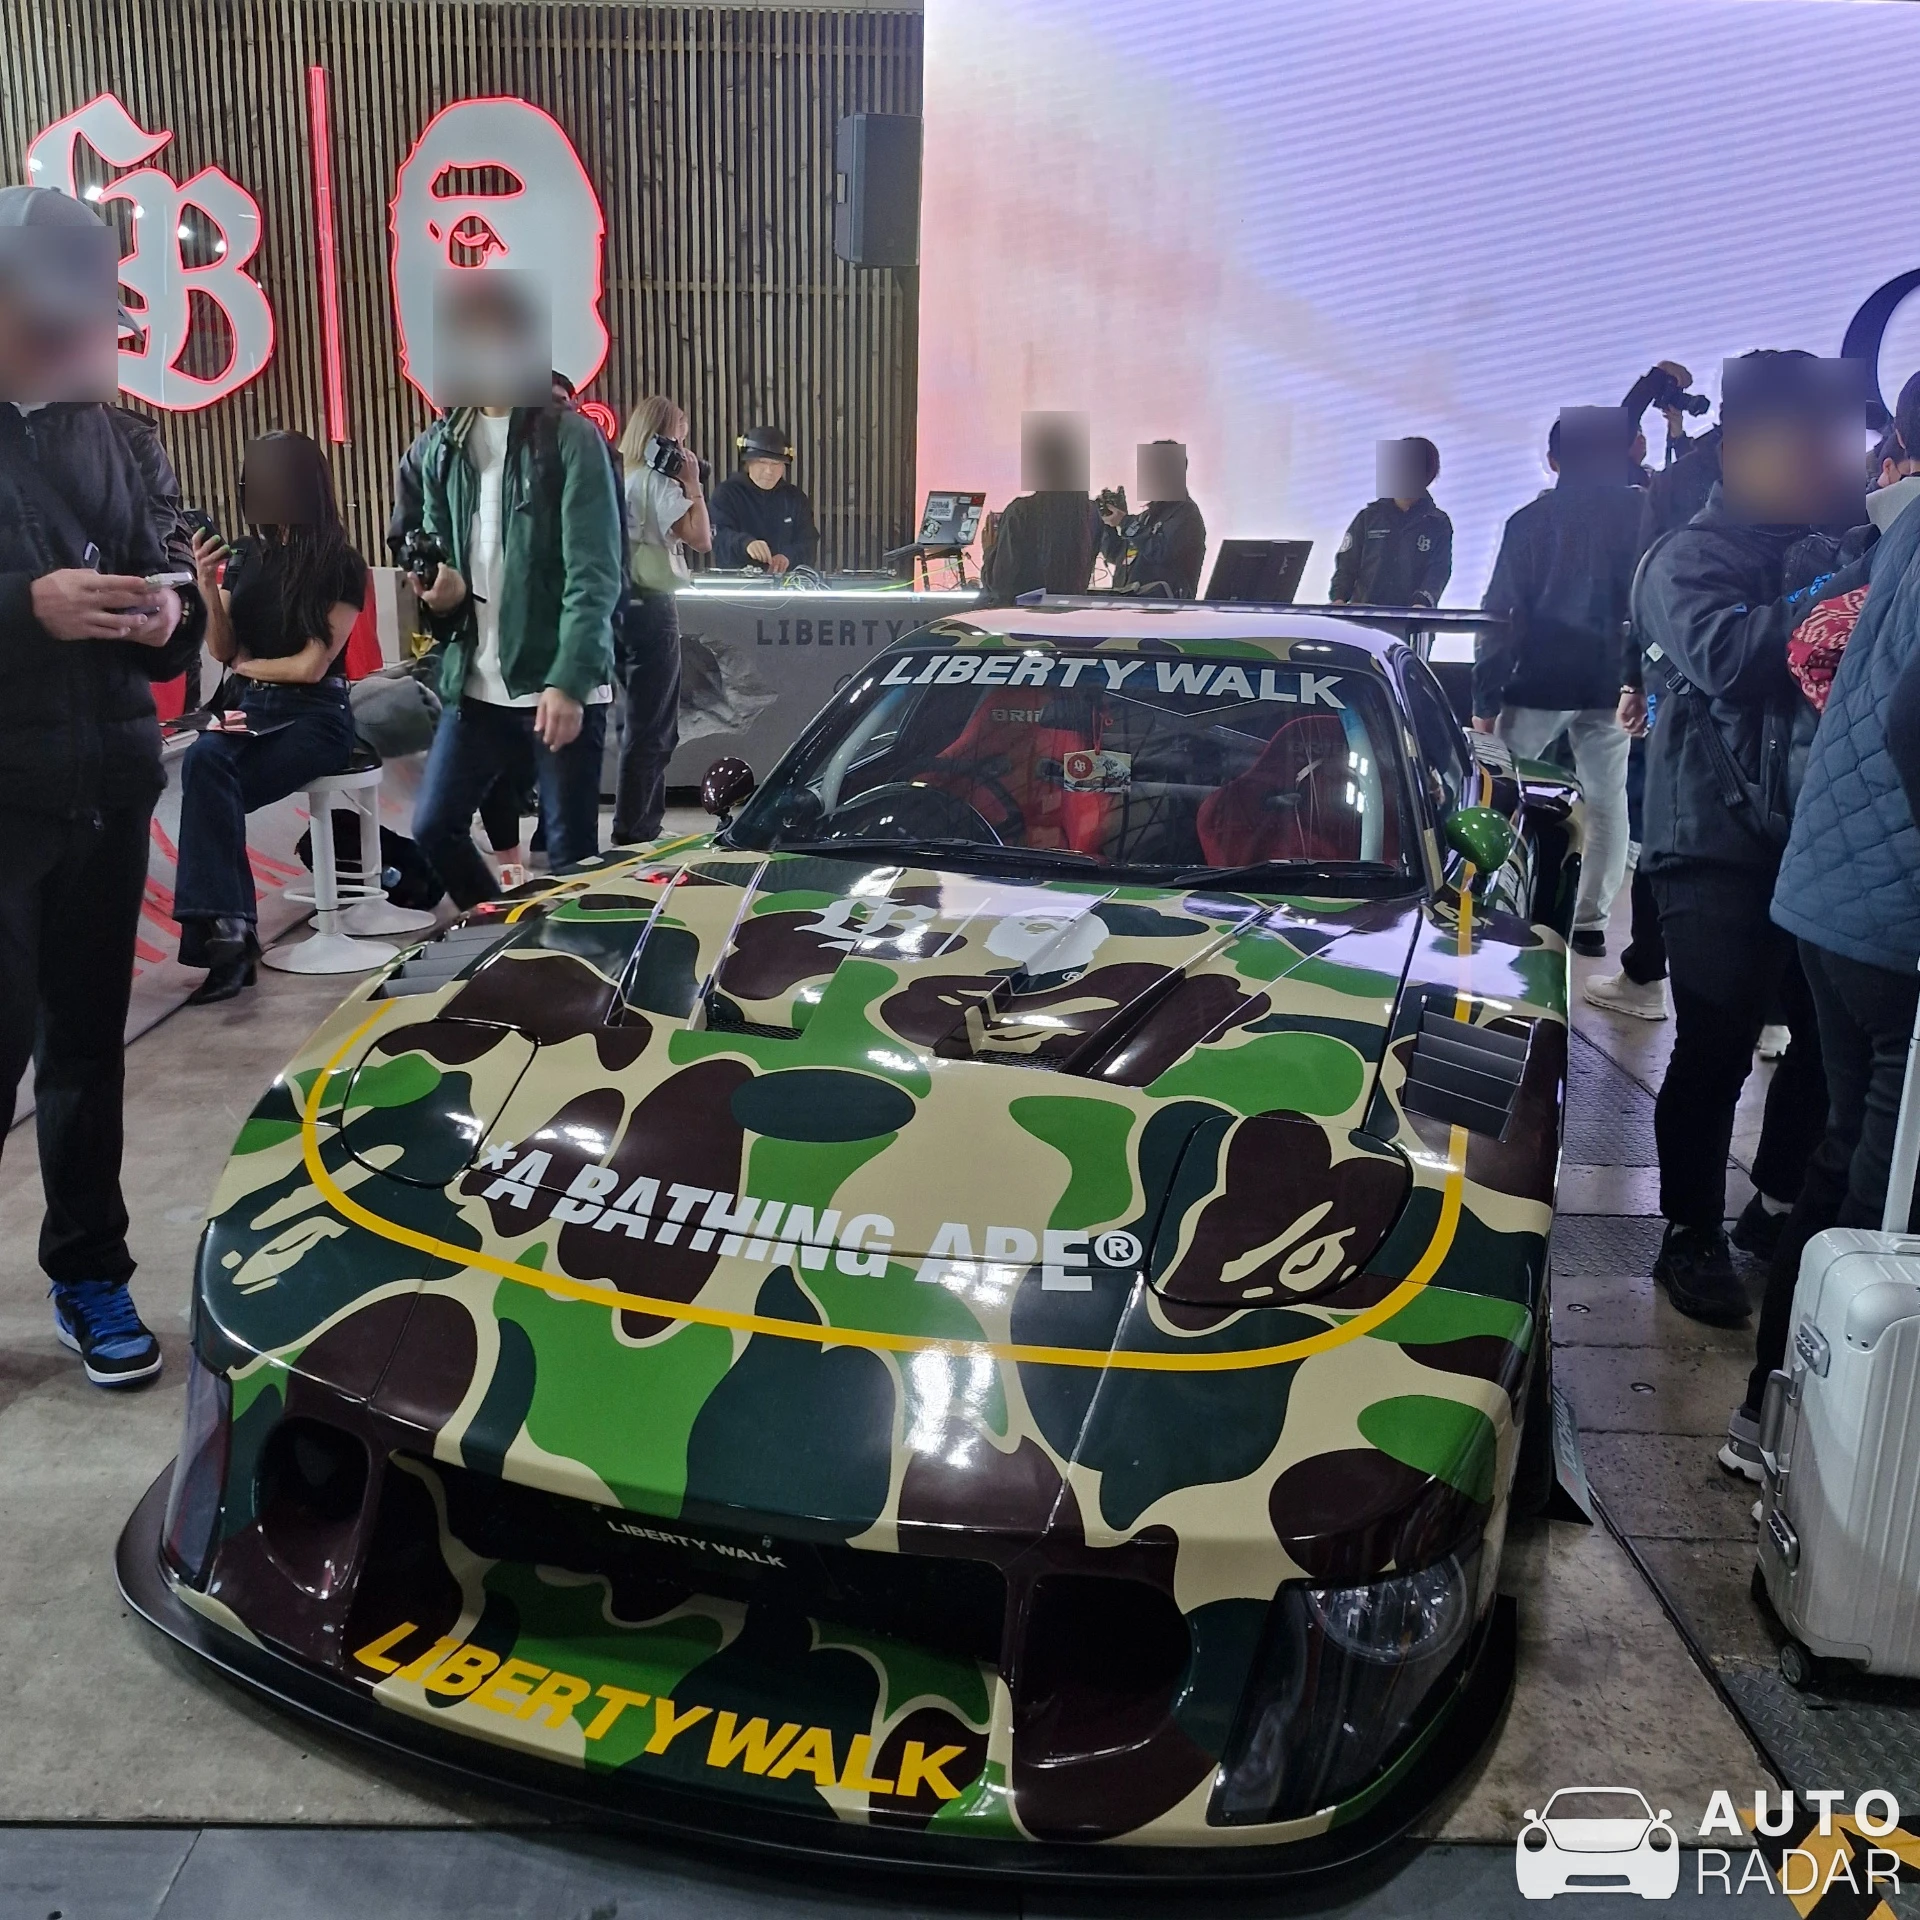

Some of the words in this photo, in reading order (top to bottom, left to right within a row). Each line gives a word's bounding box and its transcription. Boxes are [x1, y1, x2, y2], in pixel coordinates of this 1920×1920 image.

[756, 619, 902, 646] LIBERTY
[878, 655, 1145, 691] LIBERTY
[1155, 661, 1347, 710] WALK
[549, 1163, 895, 1278] BATHING
[606, 1520, 707, 1551] LIBERTY
[712, 1542, 788, 1569] WALK
